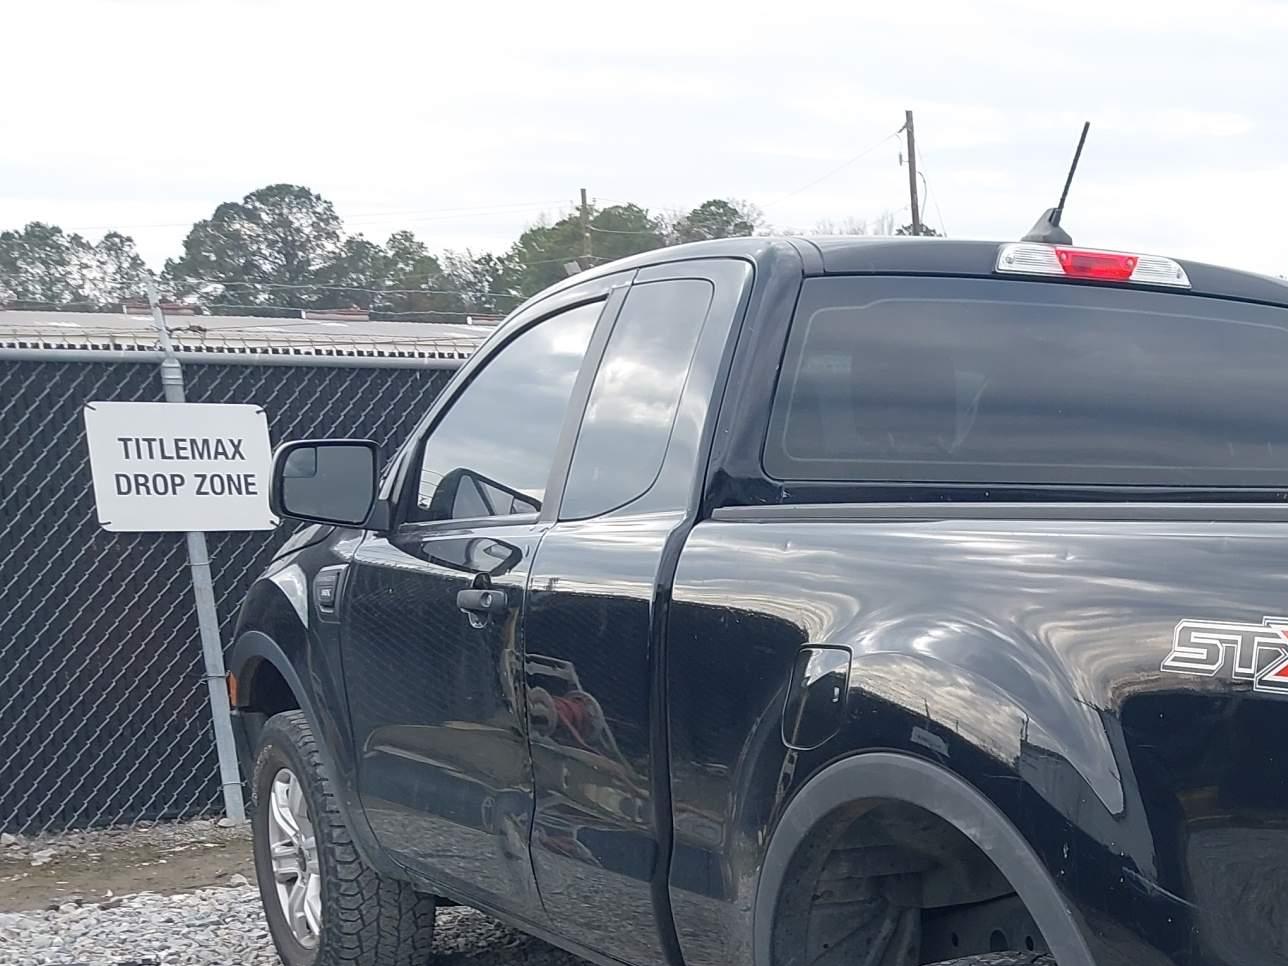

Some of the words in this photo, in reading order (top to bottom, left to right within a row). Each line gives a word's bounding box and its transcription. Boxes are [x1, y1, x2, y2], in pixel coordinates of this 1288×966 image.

[117, 437, 246, 460] TITLEMAX
[115, 473, 185, 495] DROP
[194, 473, 258, 495] ZONE
